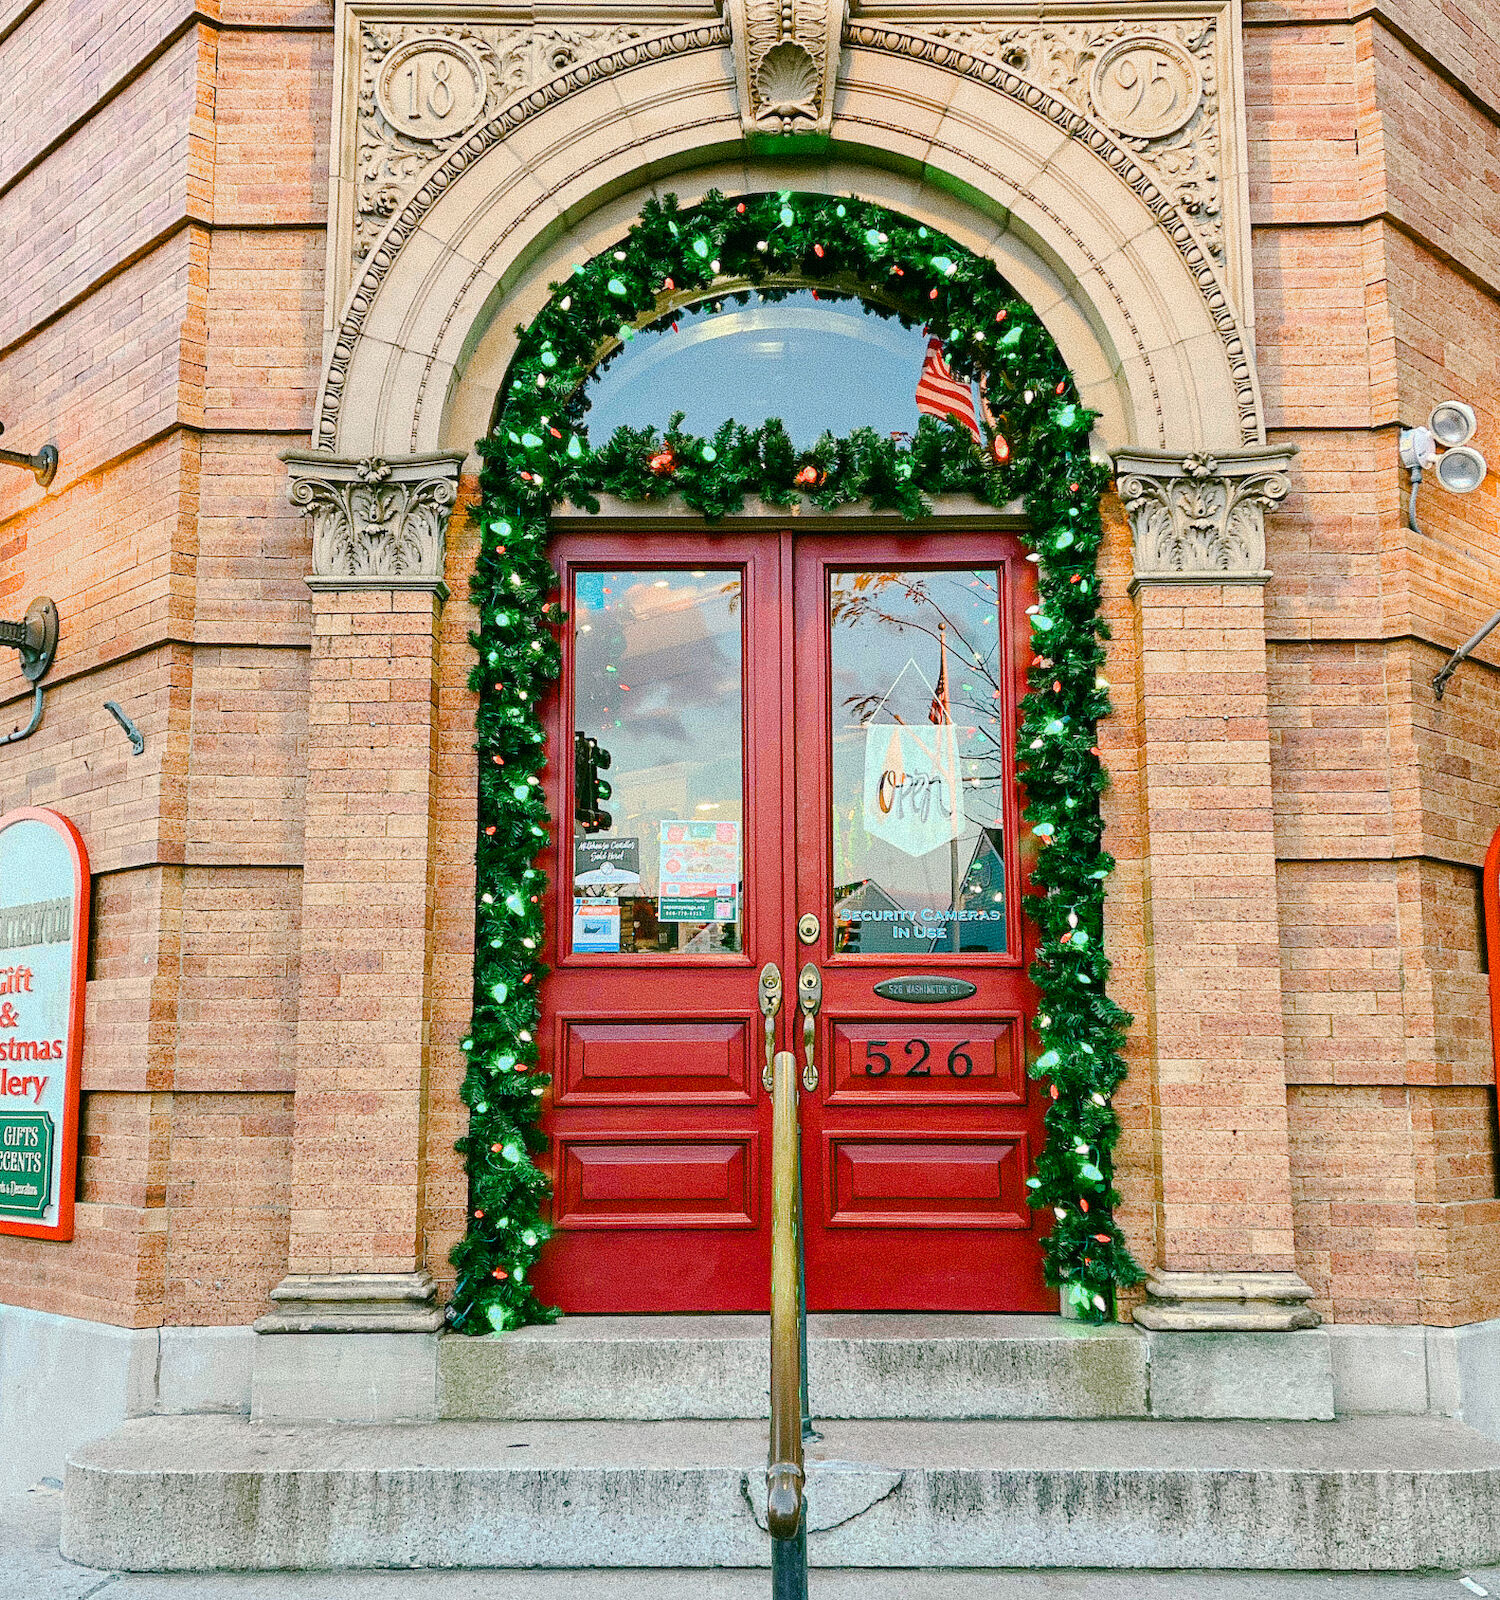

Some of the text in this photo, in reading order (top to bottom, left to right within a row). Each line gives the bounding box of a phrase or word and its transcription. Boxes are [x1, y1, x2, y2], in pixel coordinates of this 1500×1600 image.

[405, 59, 456, 120] 18
[1113, 58, 1178, 119] 95
[877, 769, 953, 824] Open
[888, 984, 904, 995] 526
[906, 983, 948, 995] WASHINGTON
[864, 1038, 974, 1079] 526
[3, 1125, 39, 1147] GIFTS
